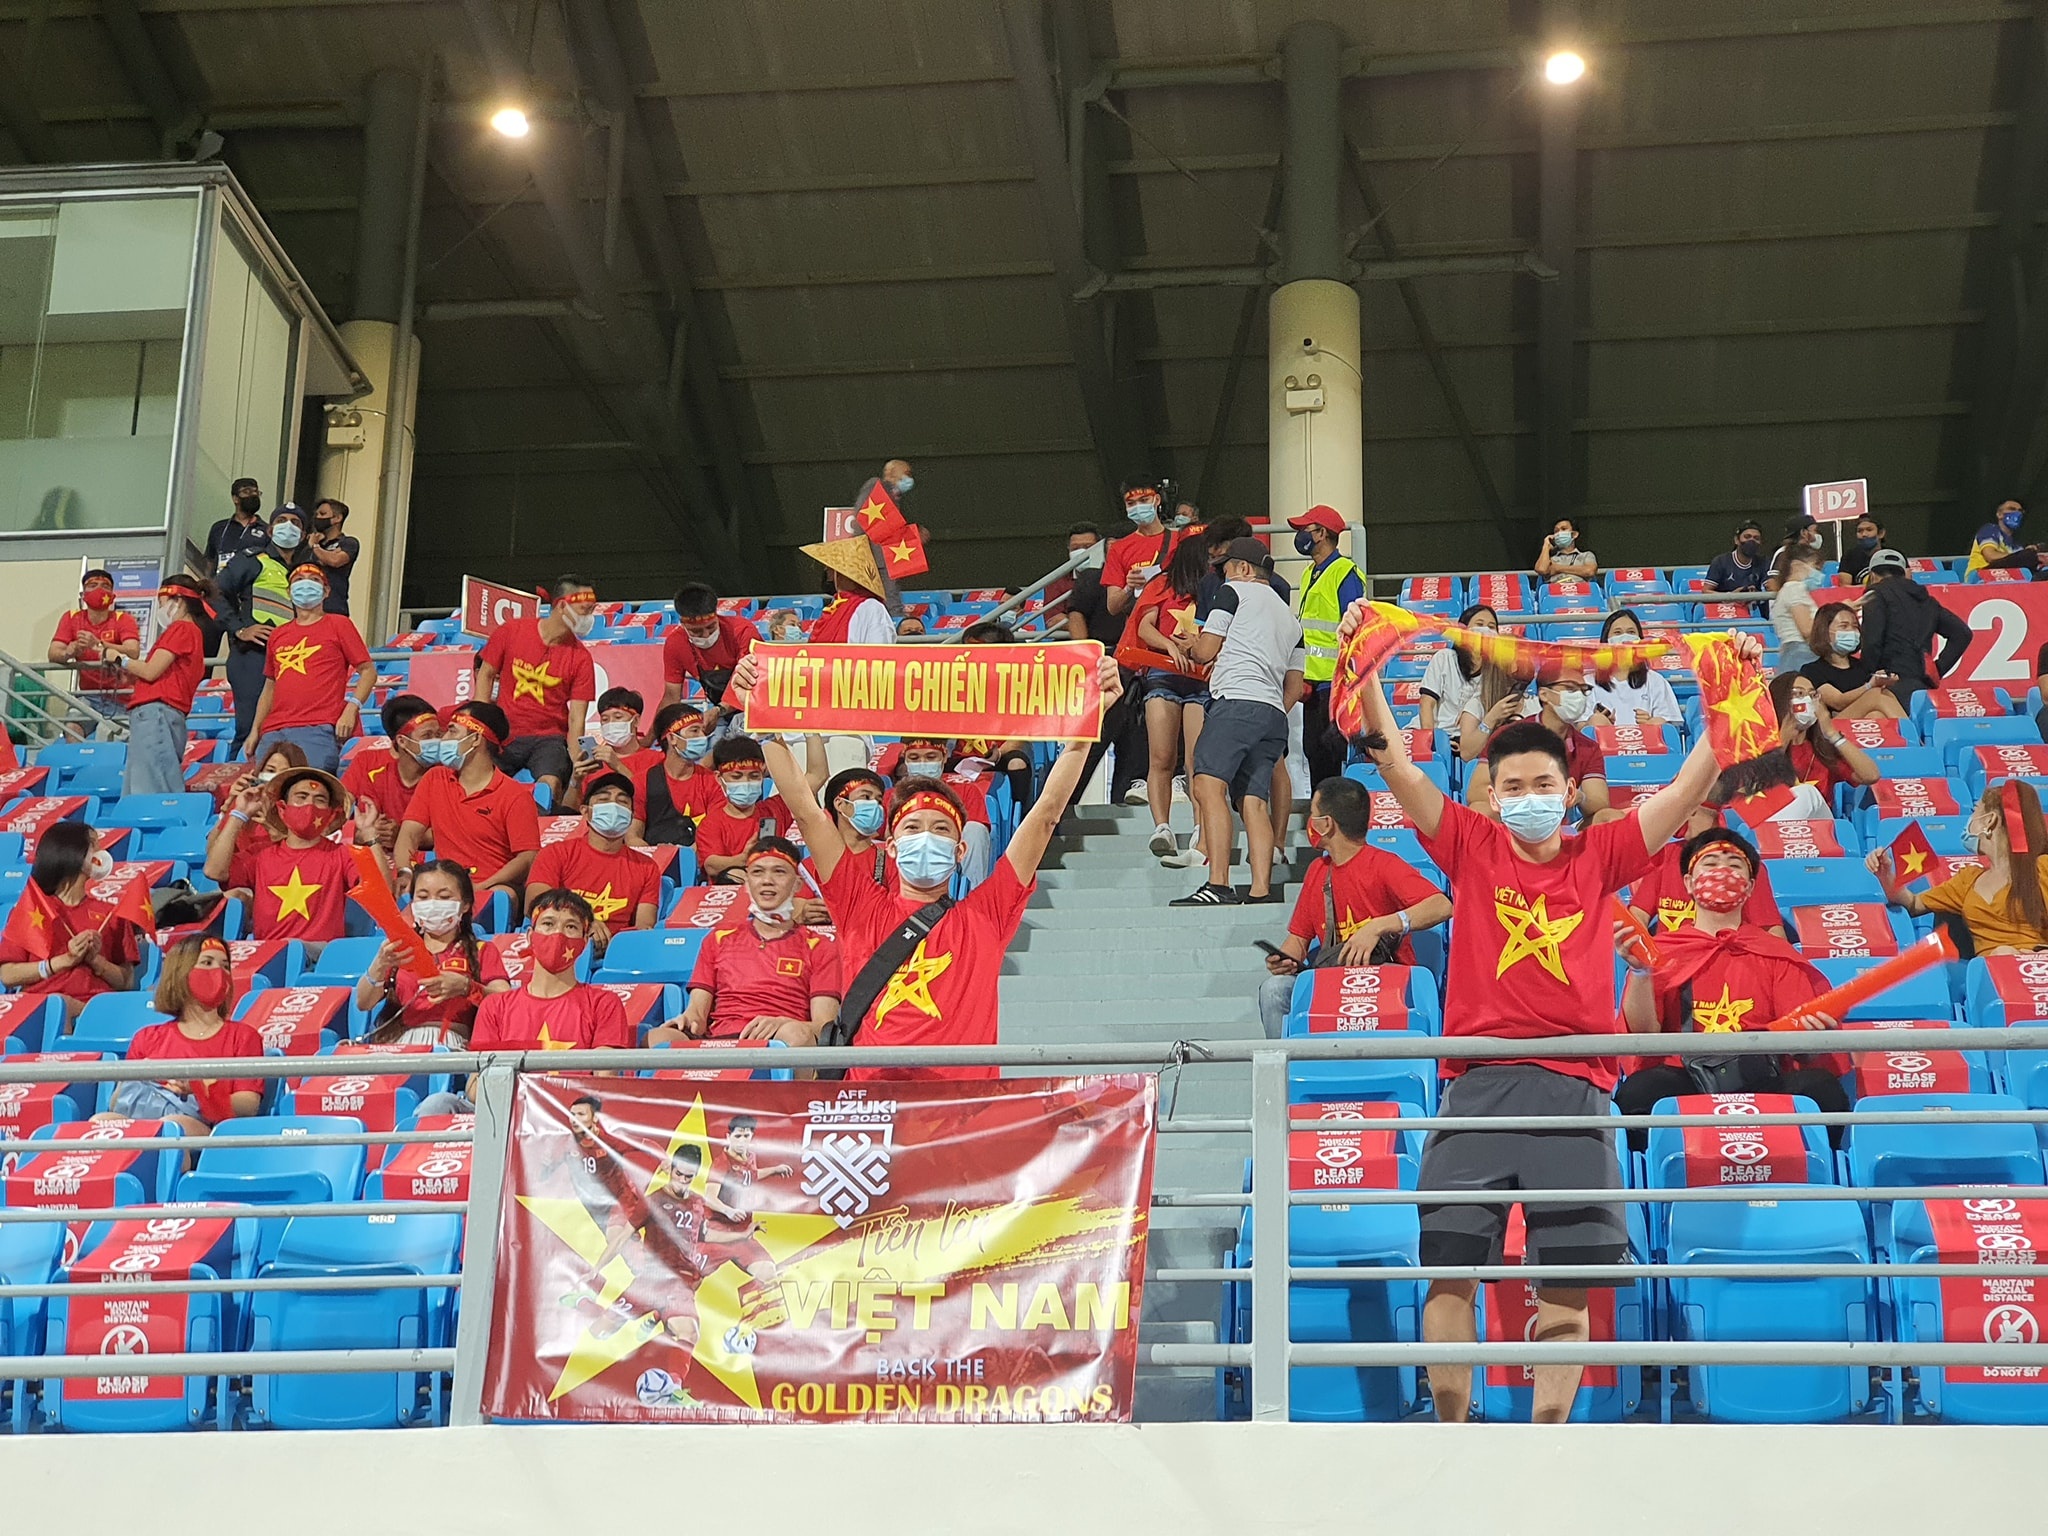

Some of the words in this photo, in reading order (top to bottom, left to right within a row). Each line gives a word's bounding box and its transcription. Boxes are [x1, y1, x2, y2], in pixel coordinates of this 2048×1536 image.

[1827, 489, 1856, 511] D2
[480, 588, 489, 626] SECTION
[767, 649, 825, 720] VIỆT
[832, 658, 896, 711] NAM
[904, 651, 988, 714] CHIẾN
[995, 649, 1086, 717] THẮNG
[1495, 885, 1516, 904] VIỆT
[1829, 948, 1870, 958] PLEASE
[1337, 1016, 1379, 1026] PLEASE
[1888, 1072, 1937, 1083] PLEASE
[837, 1089, 868, 1100] AFF
[321, 1096, 364, 1106] PLEASE
[807, 1100, 898, 1115] SUZUKI
[810, 1115, 845, 1123] CUP
[848, 1114, 893, 1123] 2020
[582, 1157, 598, 1175] 19
[1720, 1165, 1772, 1175] PLEASE
[742, 1170, 752, 1187] 21
[1314, 1167, 1364, 1179] PLEASE
[1736, 1174, 1753, 1182] NOT
[1755, 1174, 1771, 1182] SIT
[34, 1179, 81, 1189] PLEASE
[412, 1177, 459, 1188] PLEASE
[1315, 1178, 1326, 1186] DO
[1328, 1177, 1346, 1185] NOT
[1348, 1176, 1362, 1184] SIT
[674, 1210, 694, 1230] 22
[939, 1199, 986, 1253] lên
[1978, 1250, 2037, 1260] PLEASE
[101, 1273, 152, 1283] PLEASE
[1983, 1279, 2035, 1288] MAINTAIN
[1989, 1286, 2028, 1294] SOCIAL
[1983, 1293, 2035, 1302] DISTANCE
[103, 1300, 150, 1310] MAINTAIN
[780, 1267, 946, 1344] VIỆT
[970, 1281, 1131, 1331] NAM
[103, 1313, 149, 1324] DISTANCE
[877, 1358, 936, 1377] BACK
[943, 1358, 984, 1377] THE
[1984, 1369, 2000, 1377] DO
[2002, 1369, 2023, 1377] NOT
[2023, 1369, 2041, 1377] SIT
[97, 1375, 149, 1387] PLEASE
[771, 1382, 922, 1414] GOLDEN
[935, 1383, 1113, 1415] DRAGONS
